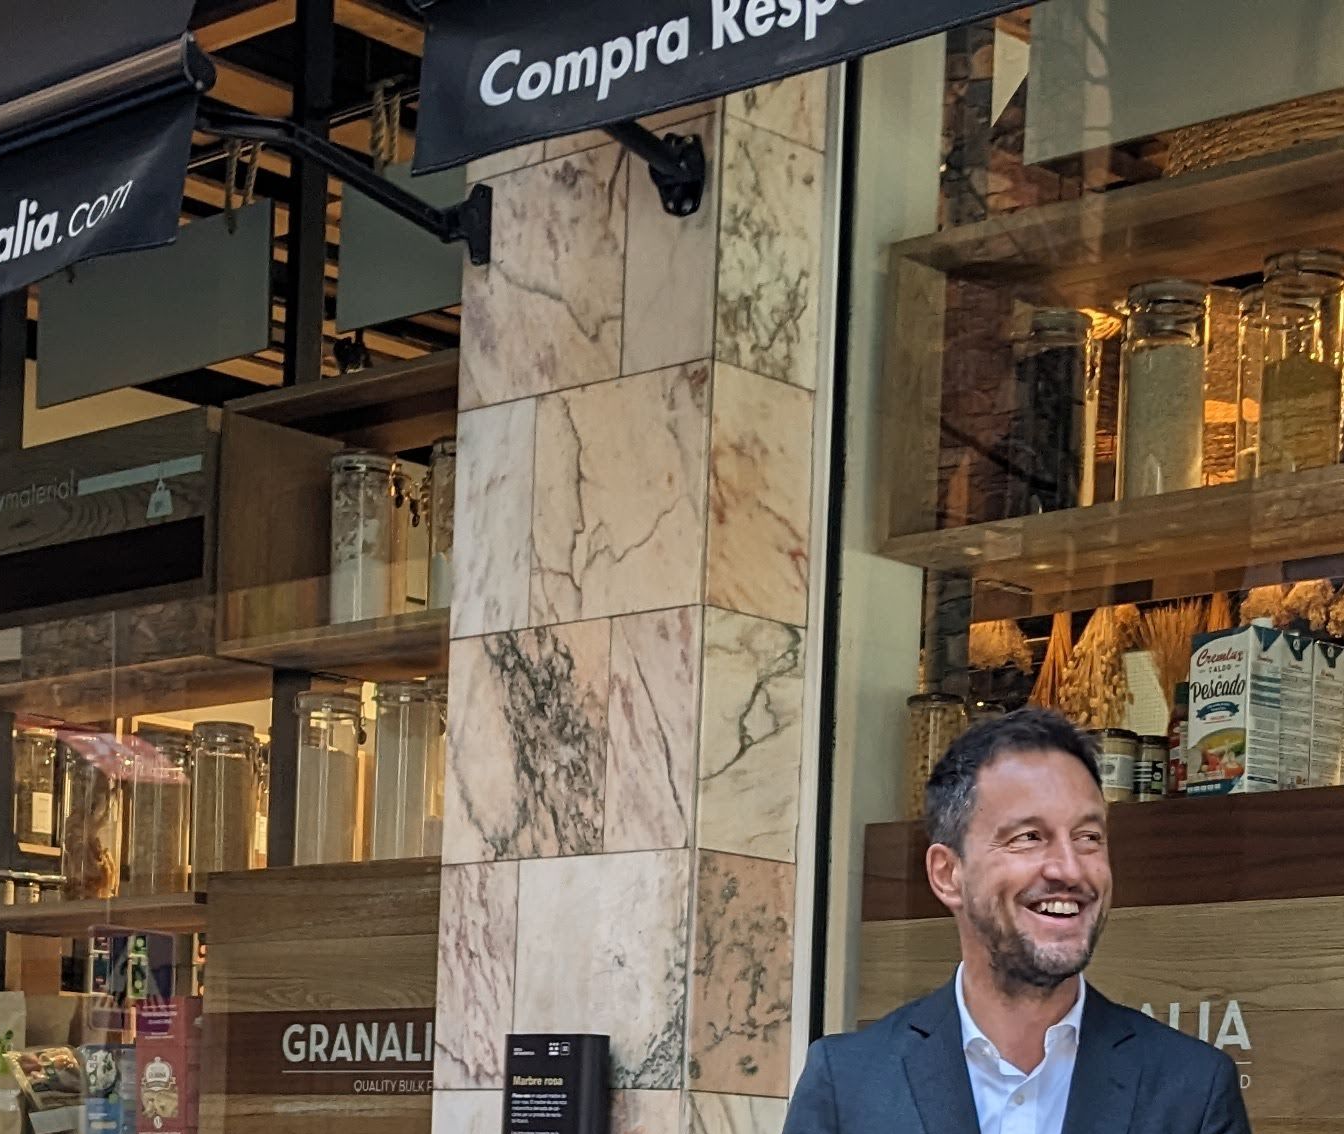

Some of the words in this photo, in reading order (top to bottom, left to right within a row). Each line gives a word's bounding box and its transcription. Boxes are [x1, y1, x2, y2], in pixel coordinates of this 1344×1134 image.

[479, 15, 690, 106] Compra
[711, 0, 864, 49] Resp
[1189, 673, 1246, 703] Pescado
[282, 1022, 433, 1062] GRANALI
[354, 1079, 397, 1092] QUALITY
[398, 1079, 424, 1092] BULK
[512, 1075, 543, 1086] Marbre
